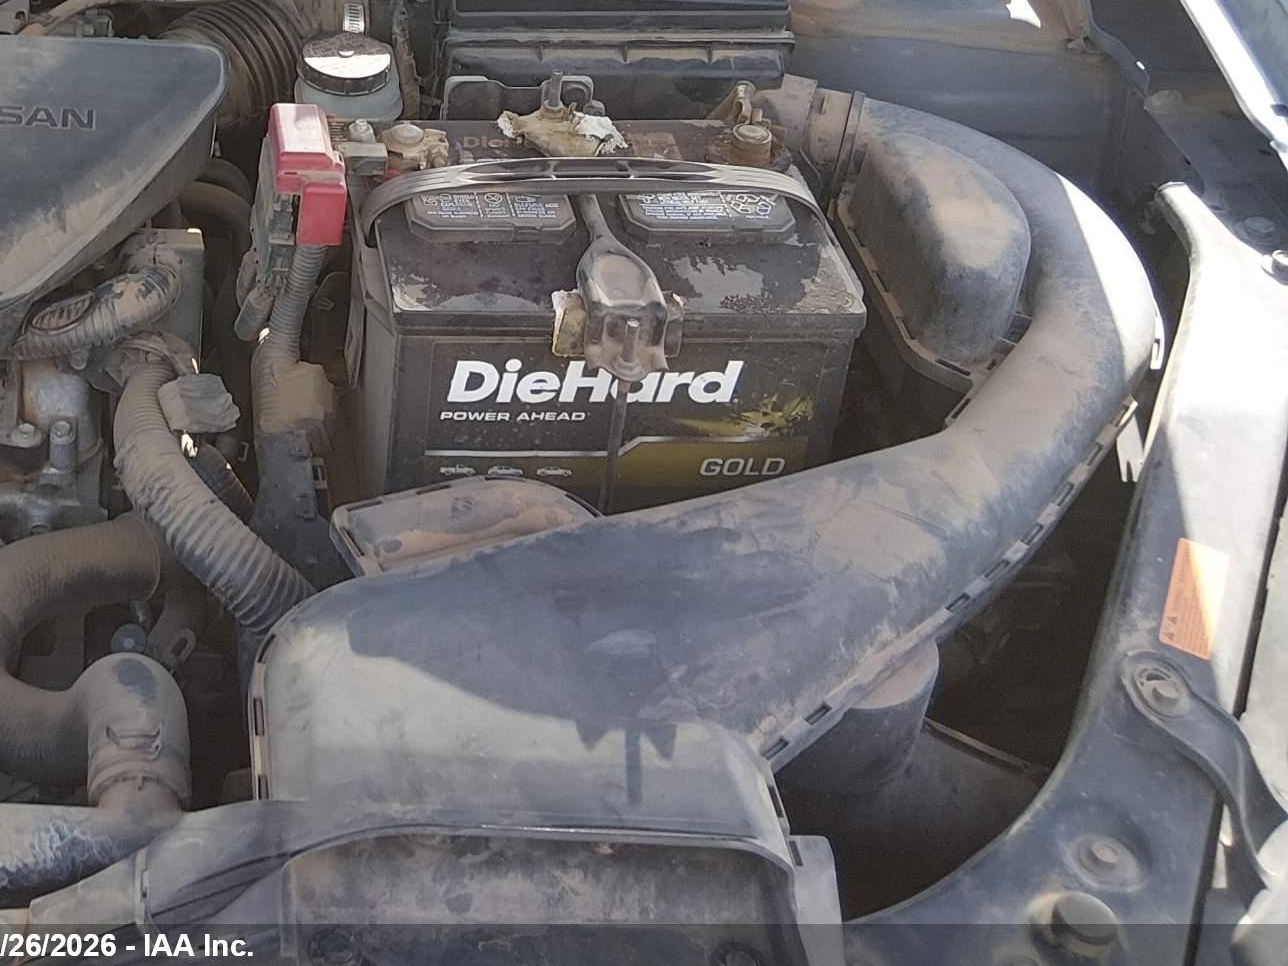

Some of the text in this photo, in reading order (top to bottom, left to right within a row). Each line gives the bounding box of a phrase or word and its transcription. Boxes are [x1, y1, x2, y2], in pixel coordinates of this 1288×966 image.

[440, 411, 586, 422] POWER AHEAD
[699, 457, 785, 476] GOLD
